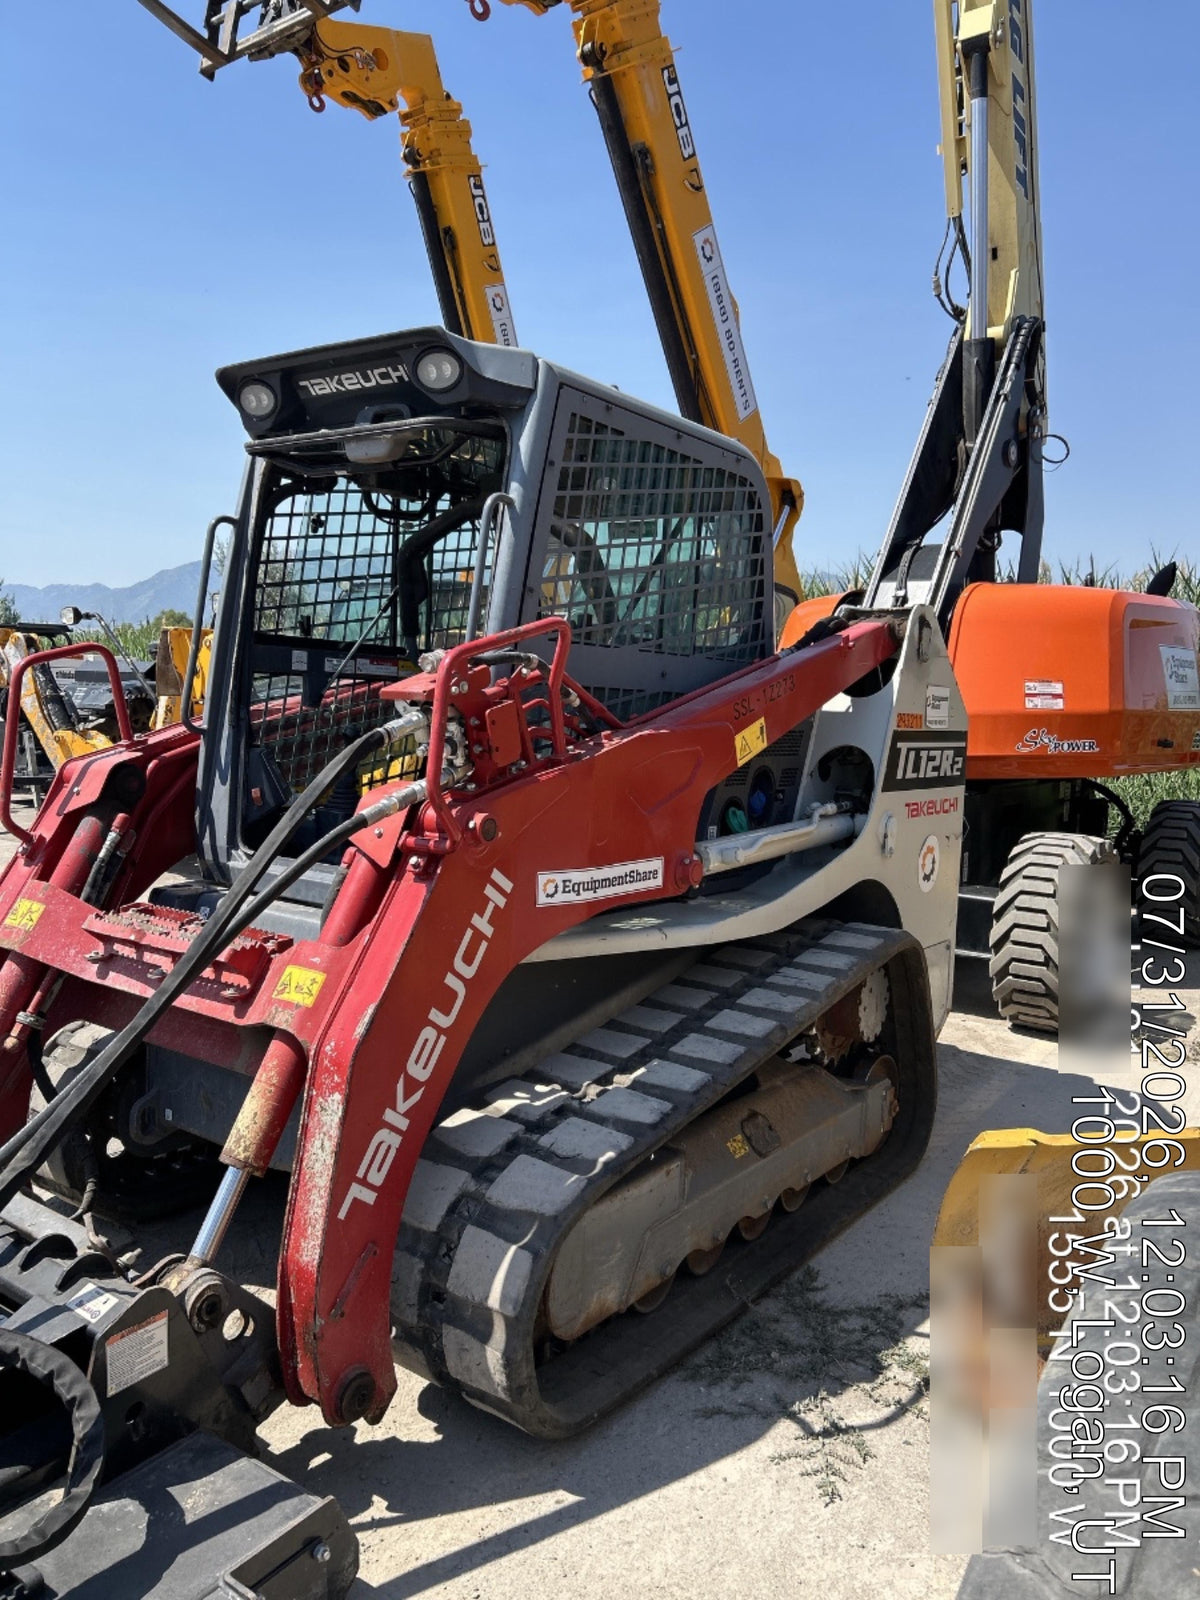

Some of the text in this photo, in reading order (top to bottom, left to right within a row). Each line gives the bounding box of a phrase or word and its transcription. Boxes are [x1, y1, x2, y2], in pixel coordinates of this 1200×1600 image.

[662, 65, 695, 160] JCB
[1012, 71, 1028, 200] LIFT
[469, 175, 494, 246] JCB
[724, 328, 750, 411] 80-RENTS
[896, 742, 966, 780] TL12R2
[905, 797, 958, 819] TAKEUCHI
[561, 869, 658, 896] EquipmentShare
[337, 868, 514, 1220] TAKEUCHI
